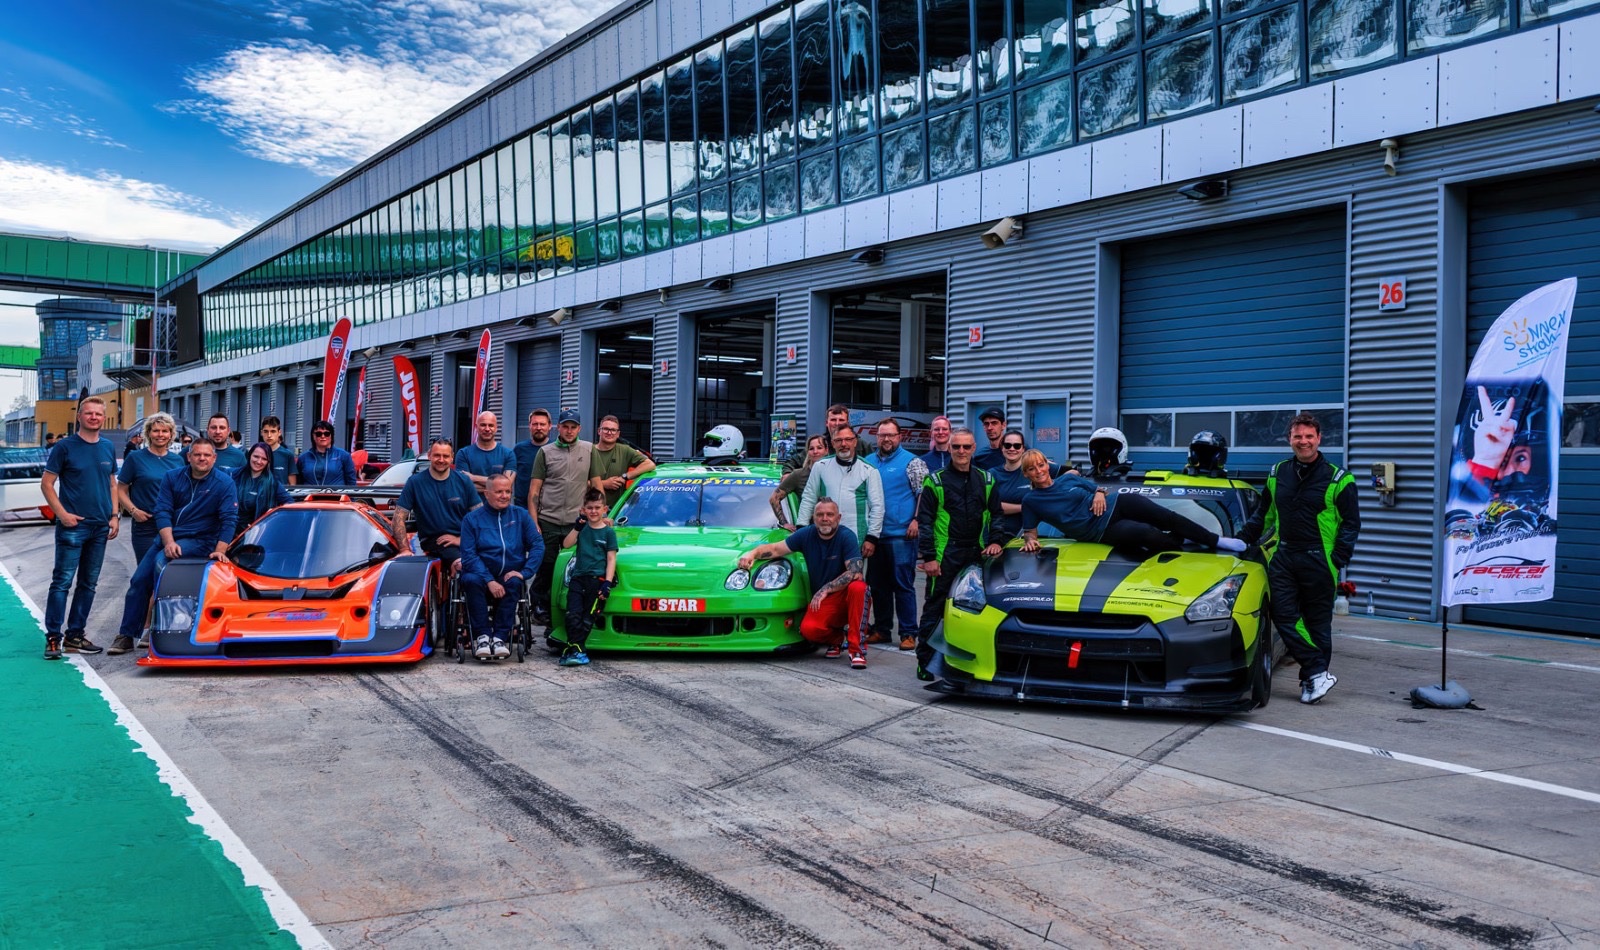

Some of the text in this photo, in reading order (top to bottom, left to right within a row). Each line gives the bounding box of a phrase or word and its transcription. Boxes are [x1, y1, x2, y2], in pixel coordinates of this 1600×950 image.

[1381, 282, 1403, 304] 26
[970, 327, 981, 342] 25
[787, 347, 795, 359] 4
[1118, 487, 1160, 495] OPEX
[1462, 565, 1550, 576] racecar
[640, 598, 697, 612] V8STAR
